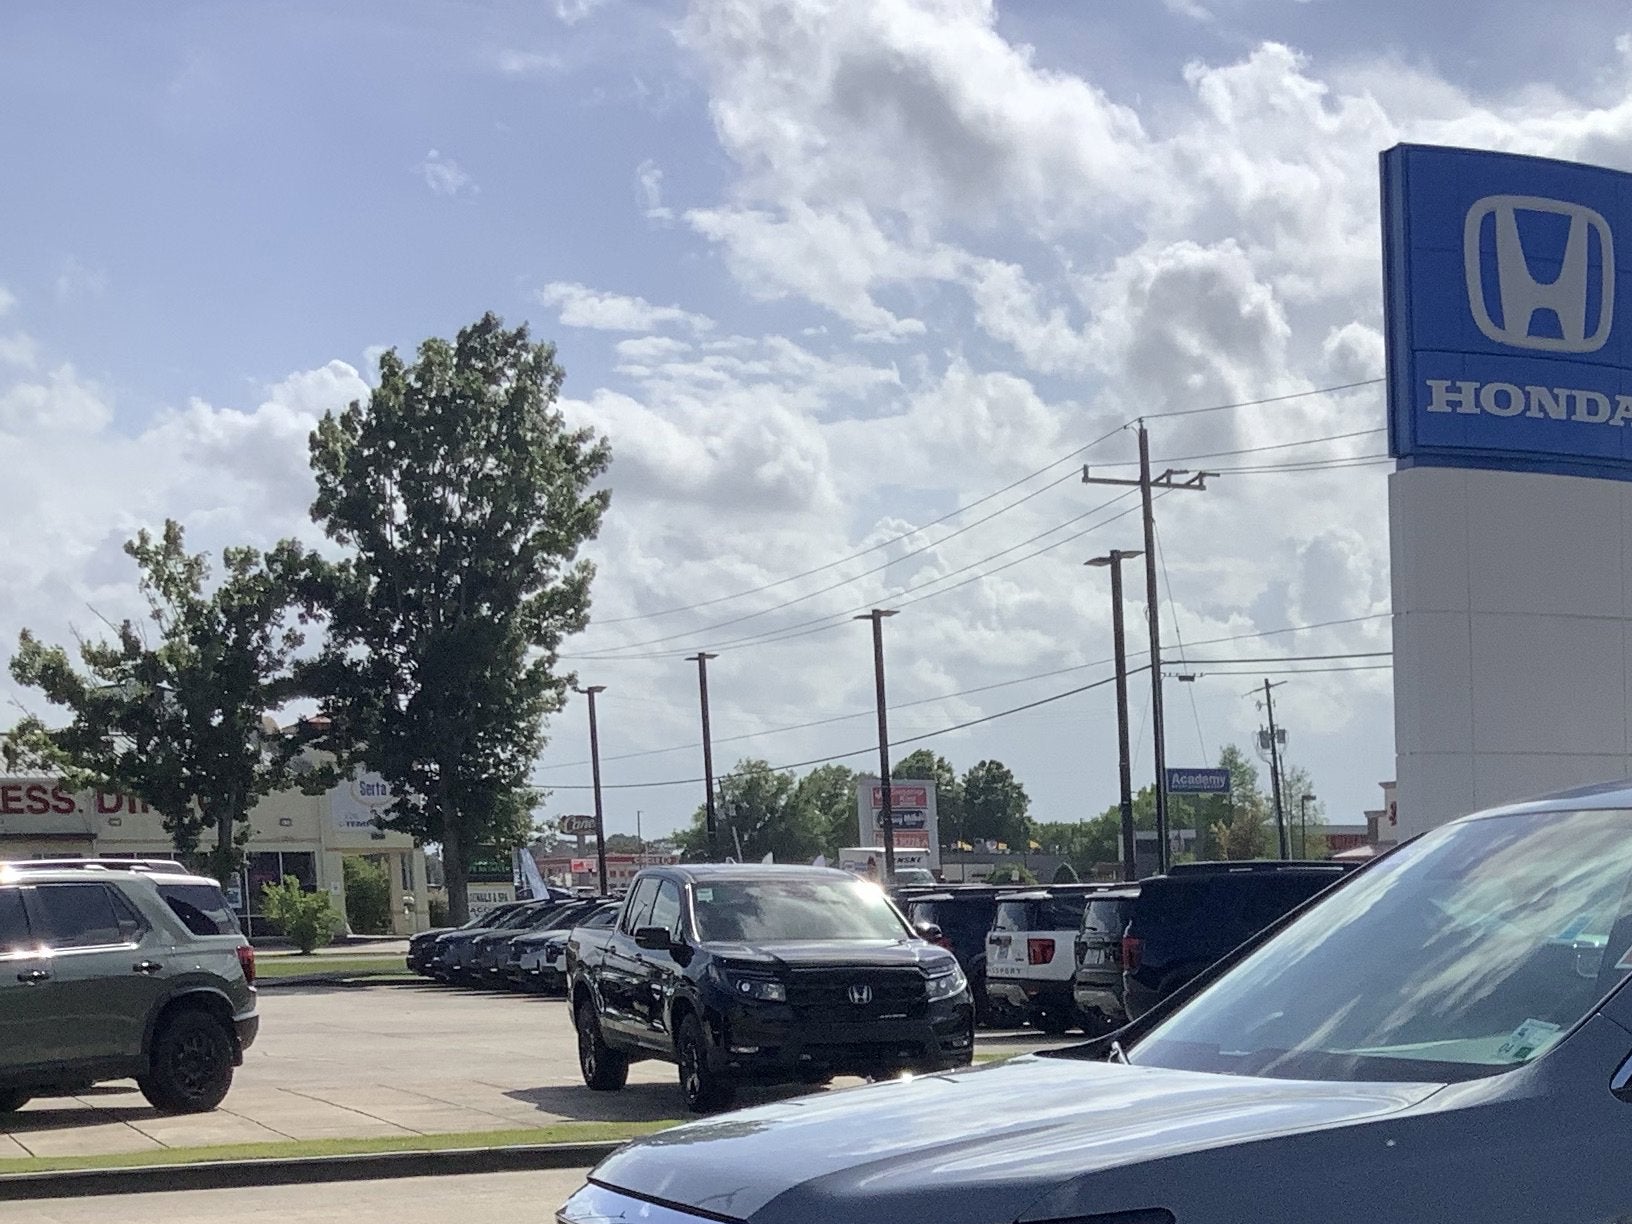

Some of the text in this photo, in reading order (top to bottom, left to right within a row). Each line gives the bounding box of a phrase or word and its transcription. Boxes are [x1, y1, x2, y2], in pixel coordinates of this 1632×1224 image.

[1172, 773, 1227, 788] Academy
[360, 781, 387, 797] Serta
[563, 815, 598, 834] Cane
